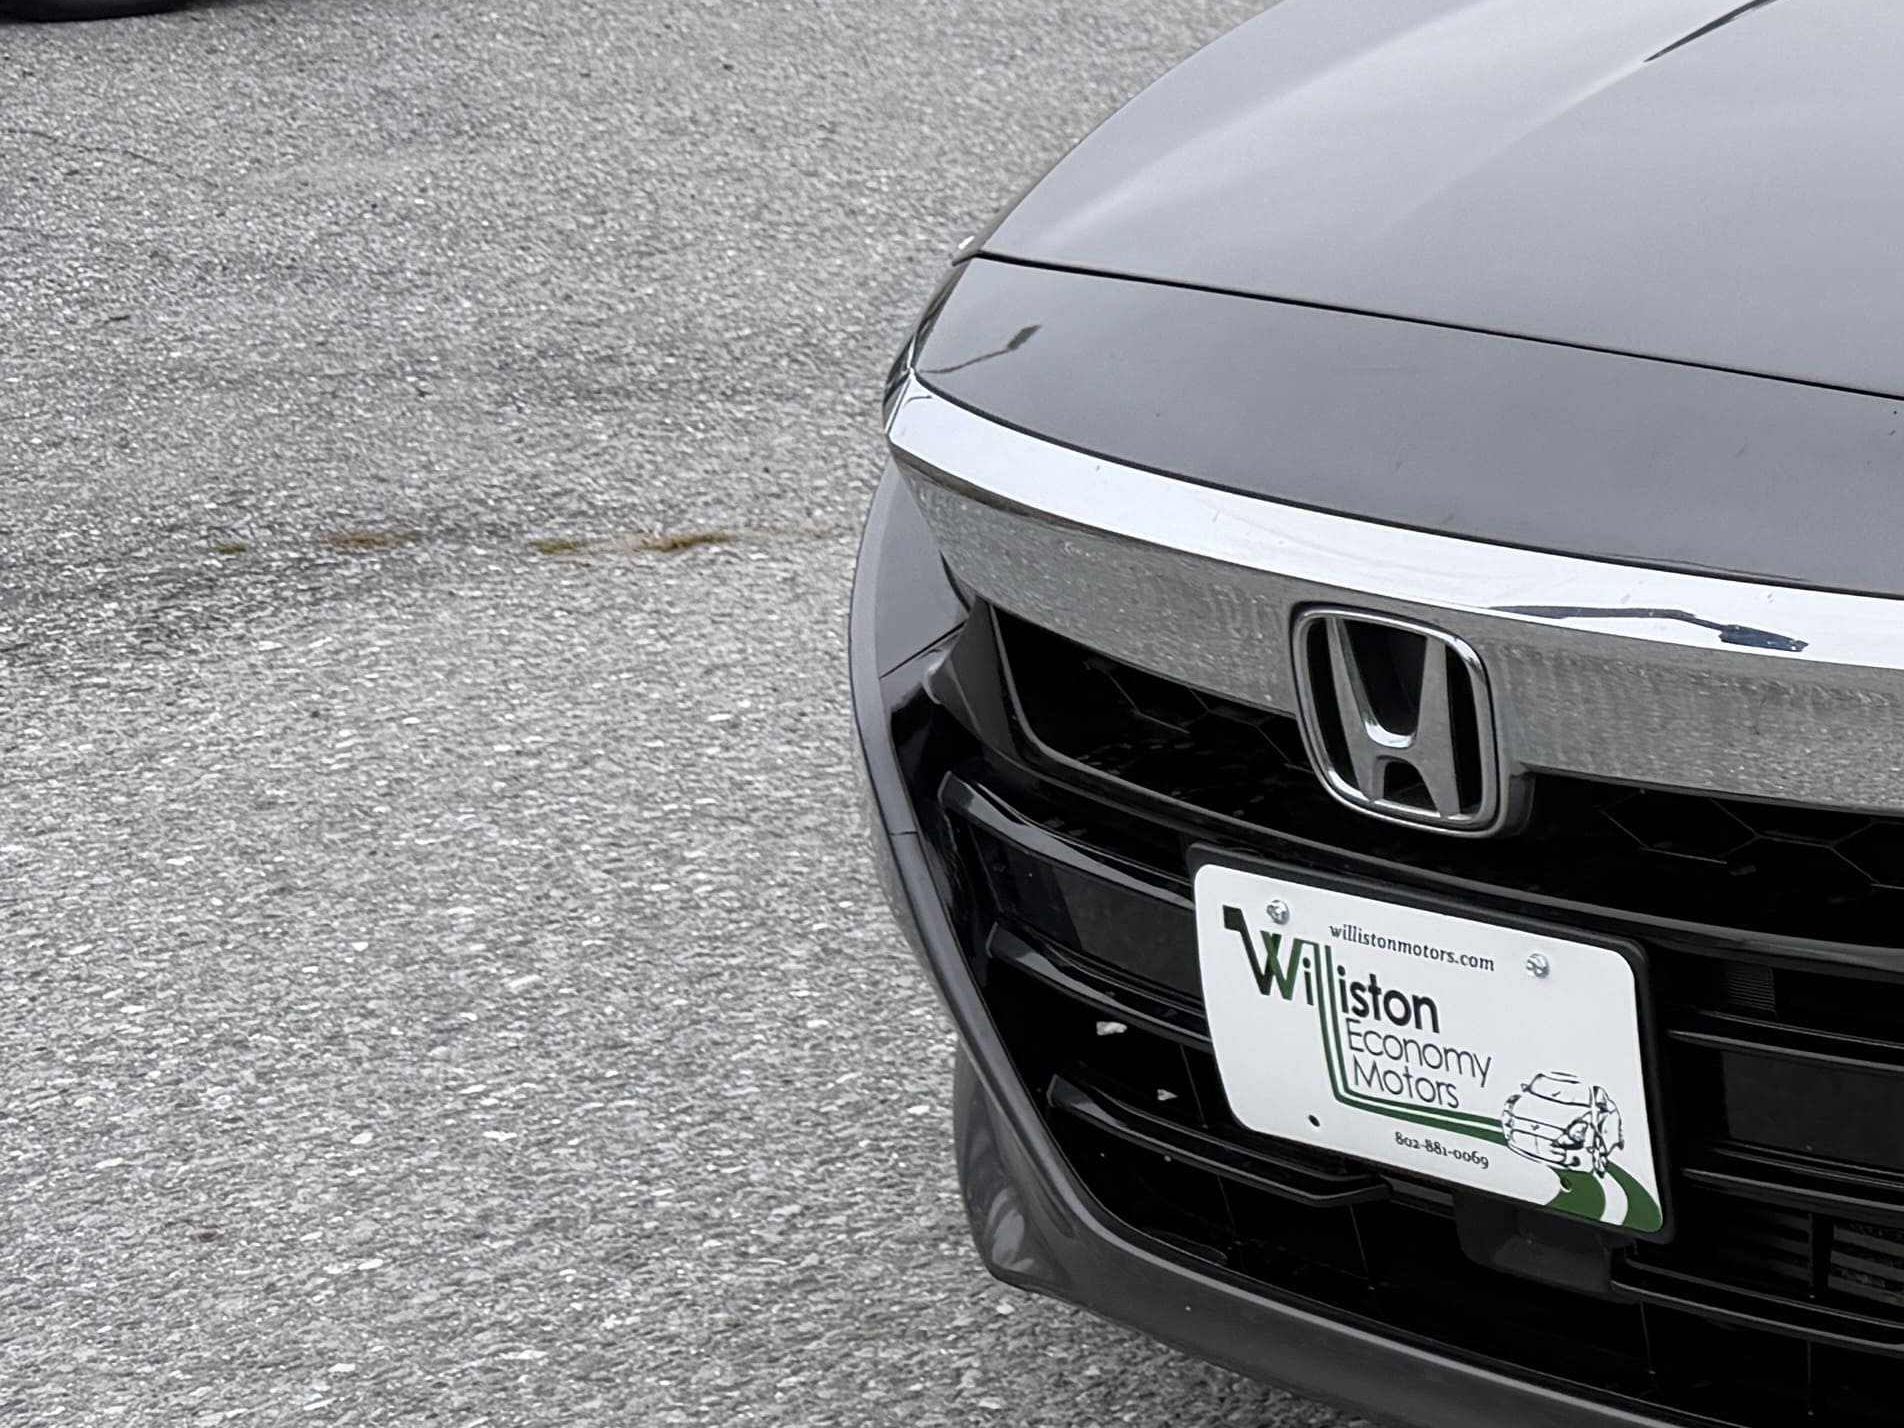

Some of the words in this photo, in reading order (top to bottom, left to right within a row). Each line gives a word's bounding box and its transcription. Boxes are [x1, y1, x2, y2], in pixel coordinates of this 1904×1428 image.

[1222, 904, 1441, 1034] Williston
[1329, 923, 1495, 972] willistonmotors.com
[1345, 1017, 1492, 1088] Economy
[1352, 1053, 1460, 1109] Motors
[1394, 1131, 1490, 1170] 802-881-0069
